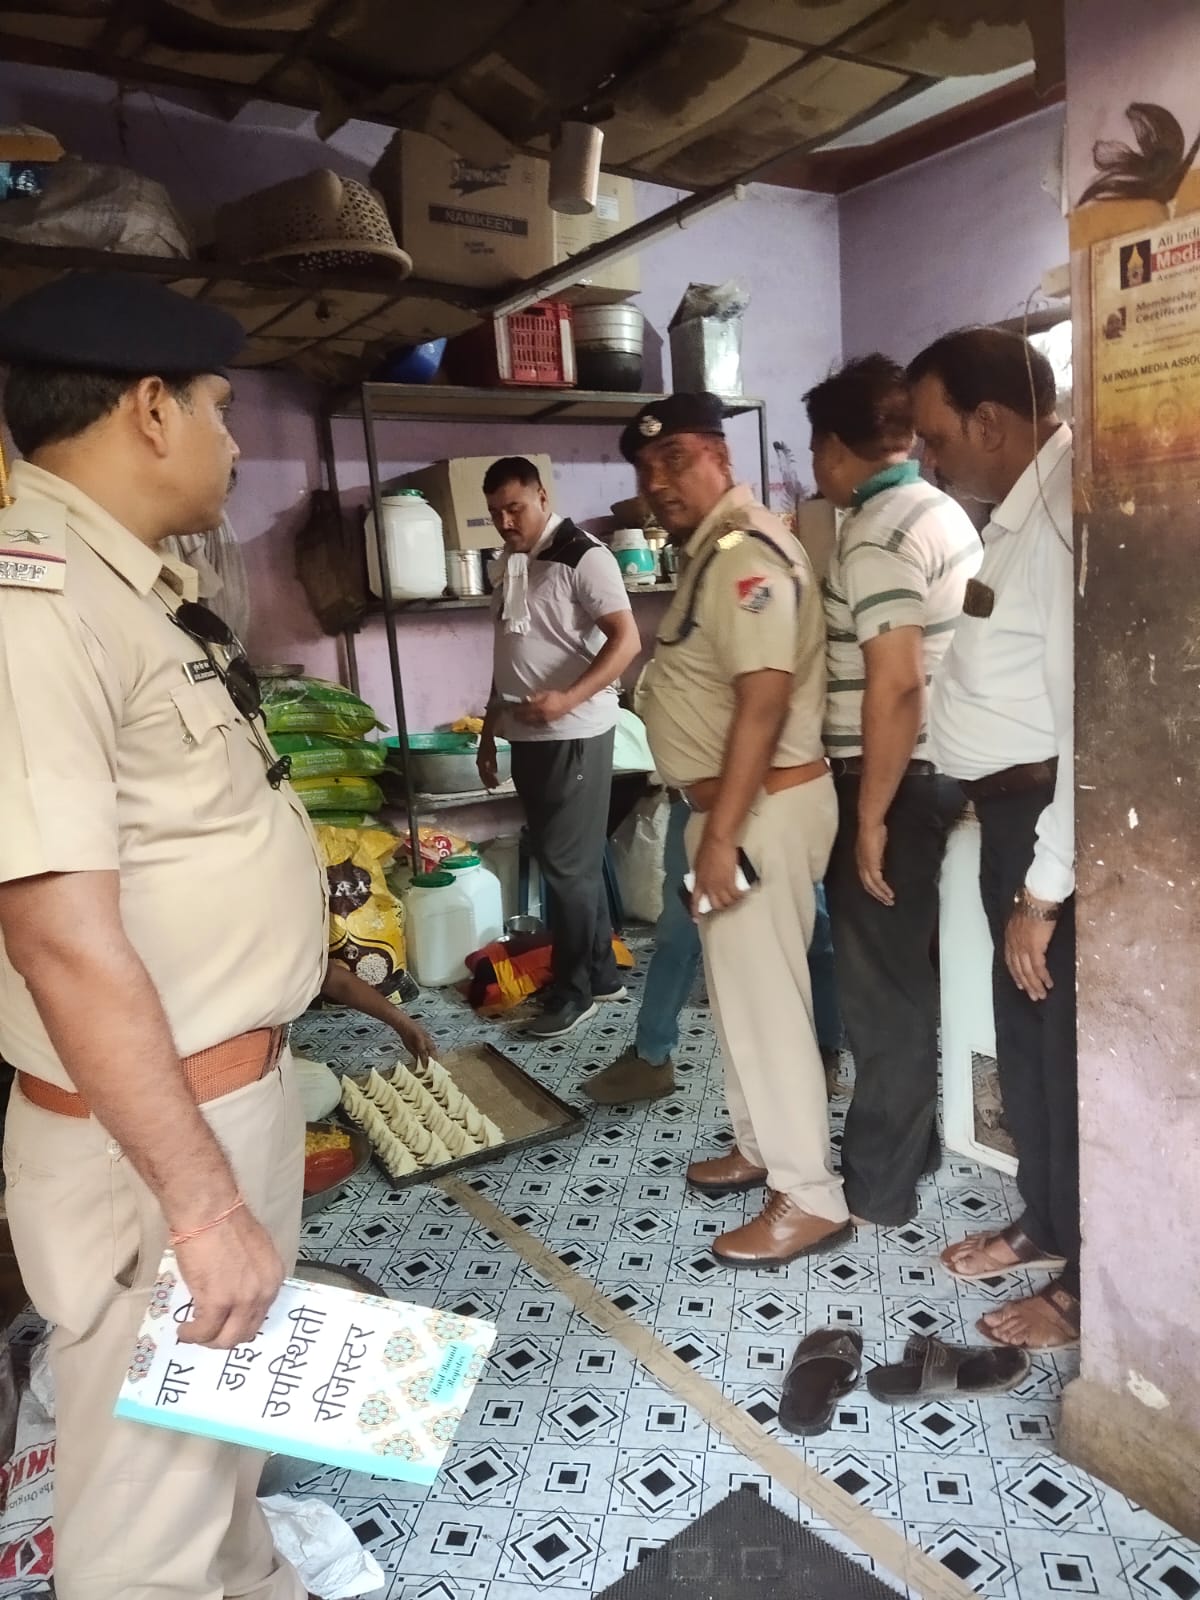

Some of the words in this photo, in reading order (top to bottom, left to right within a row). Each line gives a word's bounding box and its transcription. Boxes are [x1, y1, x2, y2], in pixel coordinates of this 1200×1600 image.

[445, 209, 513, 232] NAMKEEN
[1140, 361, 1169, 374] MEDIA
[155, 1359, 195, 1405] चार
[312, 1323, 375, 1422] रजिस्टर
